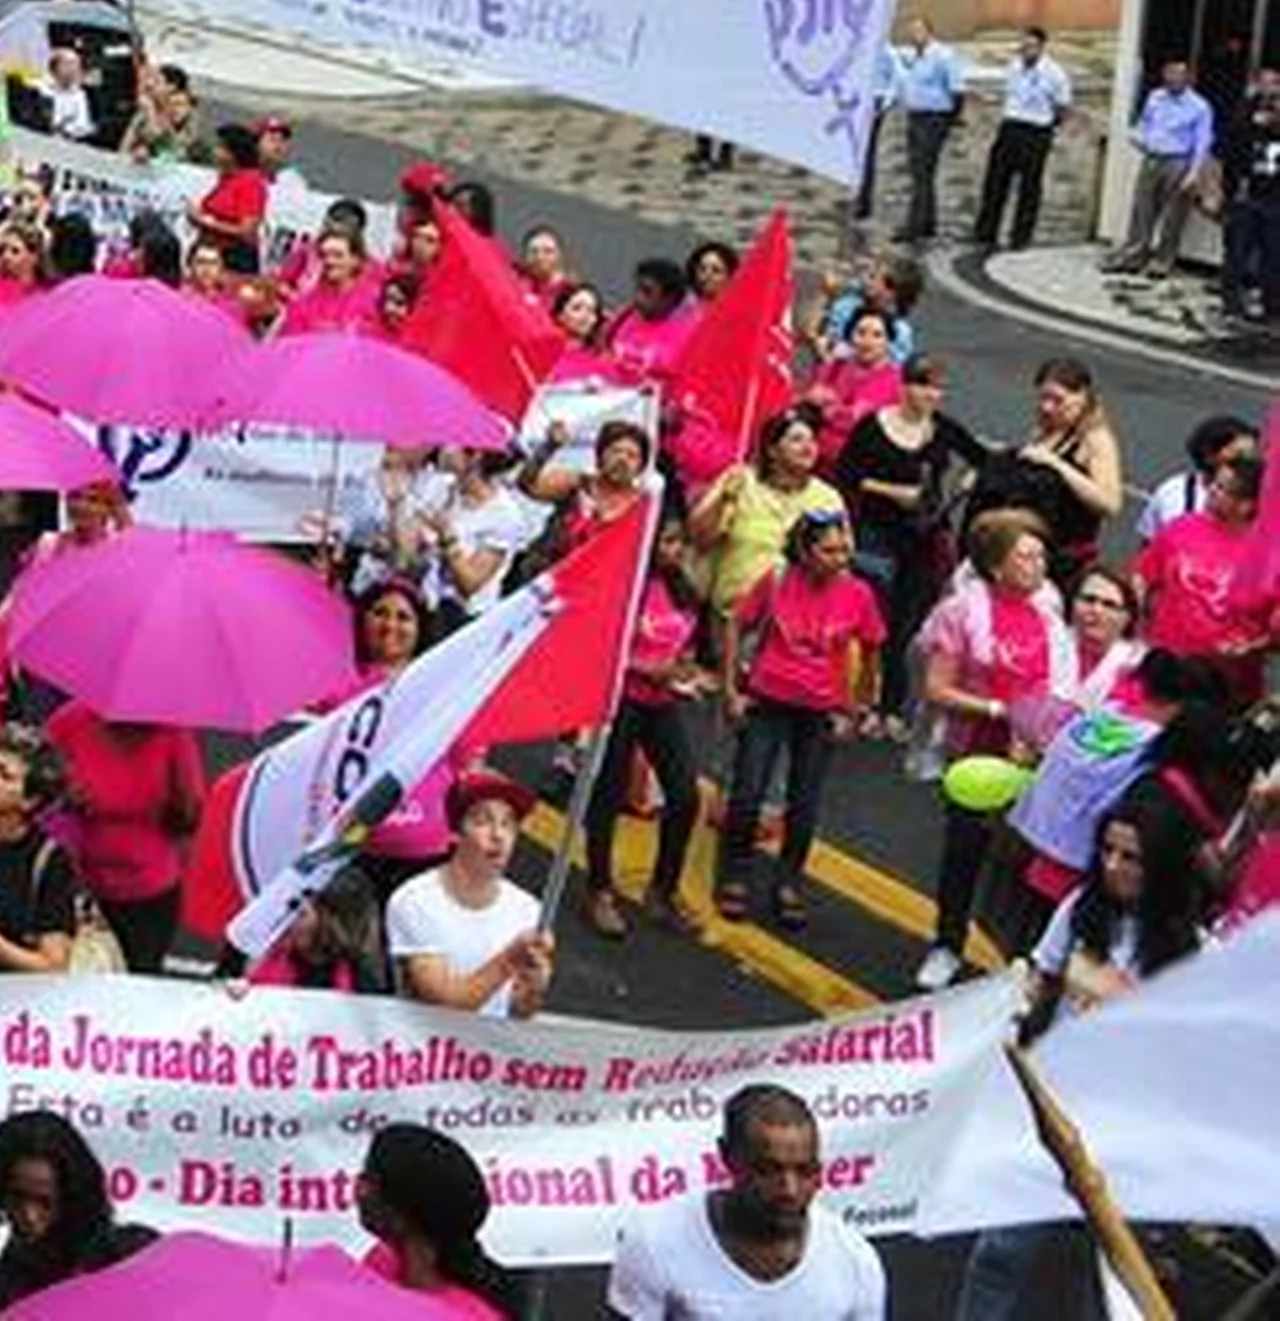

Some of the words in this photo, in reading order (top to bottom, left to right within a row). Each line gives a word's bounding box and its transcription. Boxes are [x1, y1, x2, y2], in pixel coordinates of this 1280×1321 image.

[4, 1011, 51, 1069] da
[63, 1015, 238, 1087] Jornada
[248, 1036, 297, 1088] de
[308, 1035, 494, 1091] Trabalho
[506, 1056, 588, 1092] sem
[126, 1097, 148, 1132] é
[172, 1108, 198, 1134] a
[221, 1105, 303, 1139] luta
[178, 1160, 265, 1208] Dia
[630, 1157, 688, 1212] da
